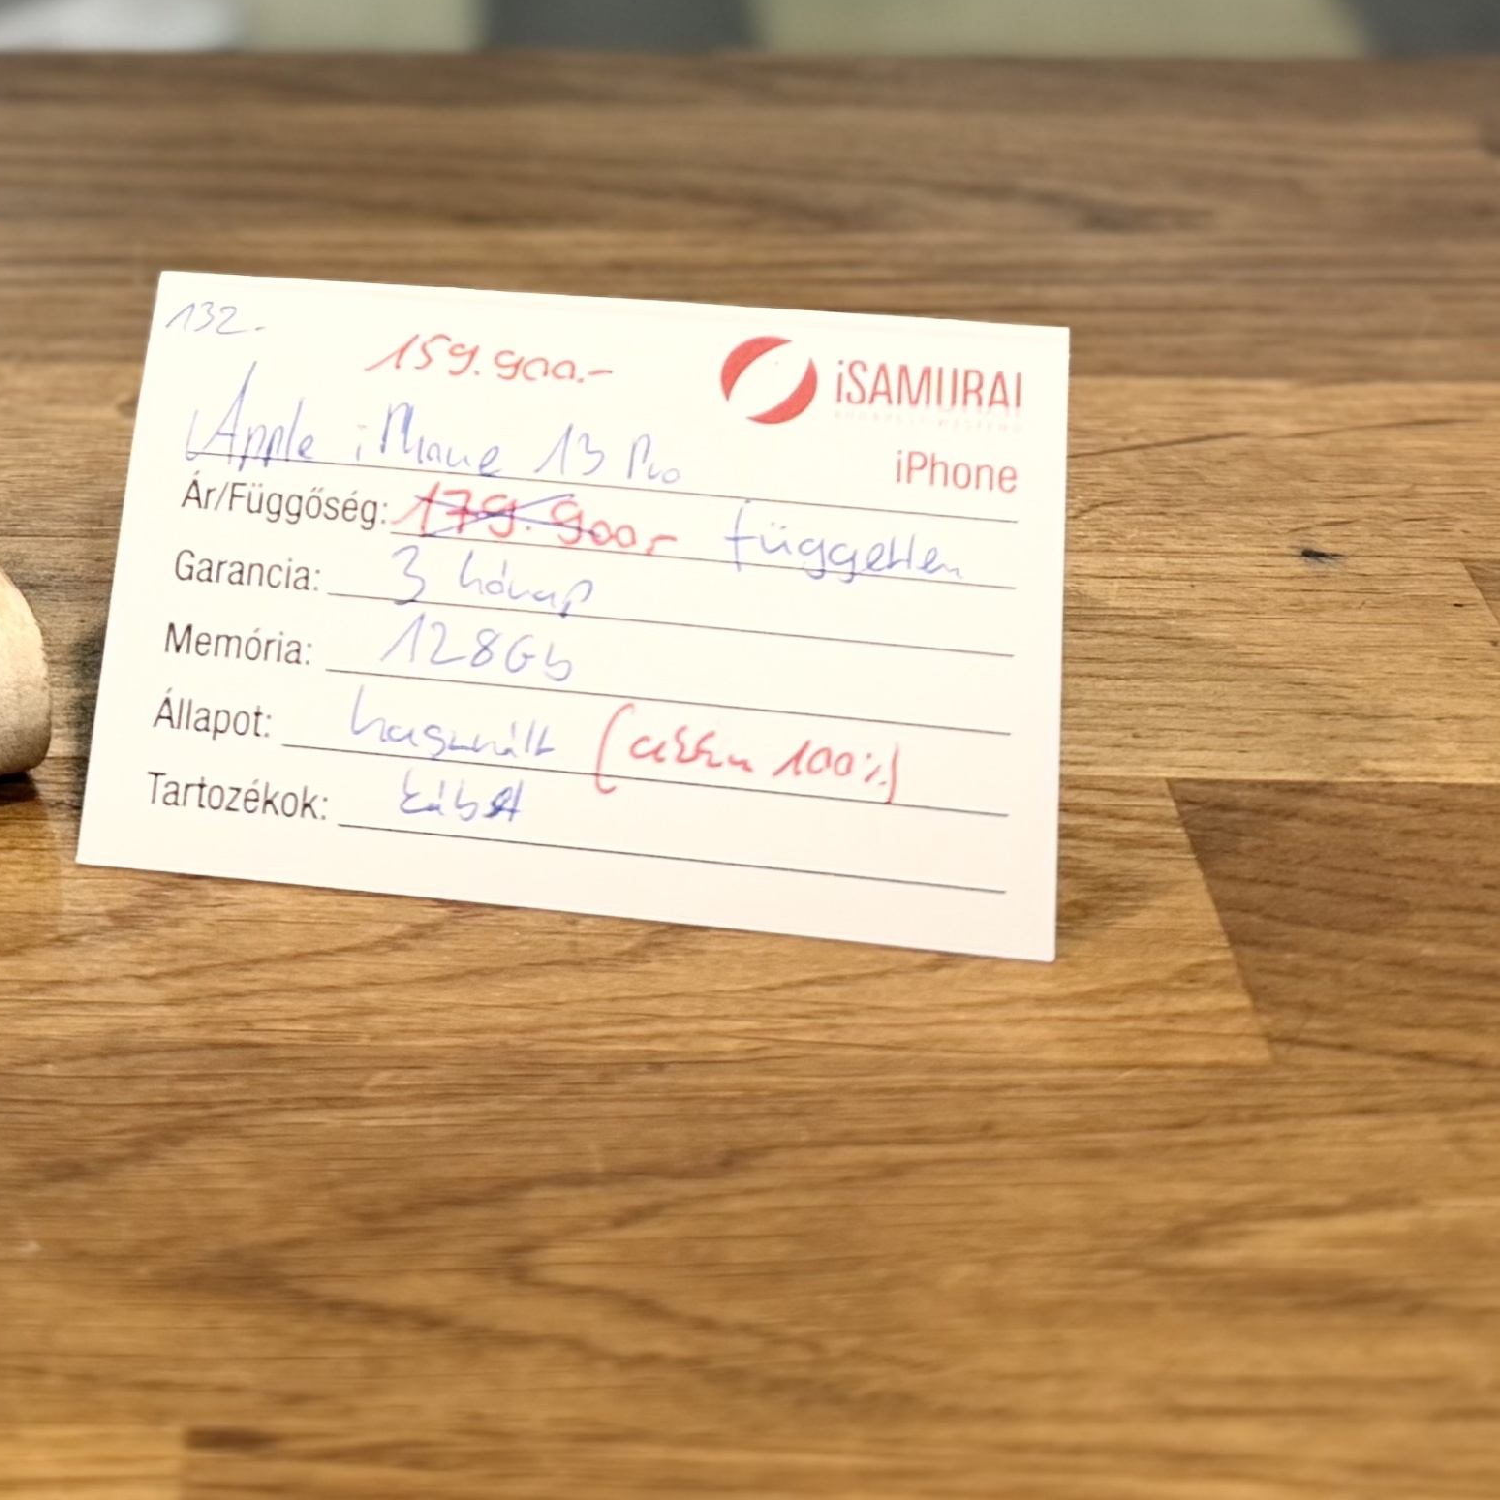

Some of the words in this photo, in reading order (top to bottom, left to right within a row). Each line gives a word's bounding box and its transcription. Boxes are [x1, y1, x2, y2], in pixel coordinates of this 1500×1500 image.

[835, 359, 1023, 411] iSAMURAI
[185, 360, 314, 471] Apple
[533, 422, 604, 477] 13
[627, 434, 681, 485] Pro
[895, 449, 1019, 493] iPhone
[181, 472, 389, 531] Ár/Függőség:
[175, 549, 321, 592] Garancia:
[391, 544, 426, 606] 3
[459, 549, 594, 618] hónap
[164, 622, 312, 666] Memória:
[153, 687, 271, 741] Állapot:
[147, 771, 329, 822] Tartozékok:
